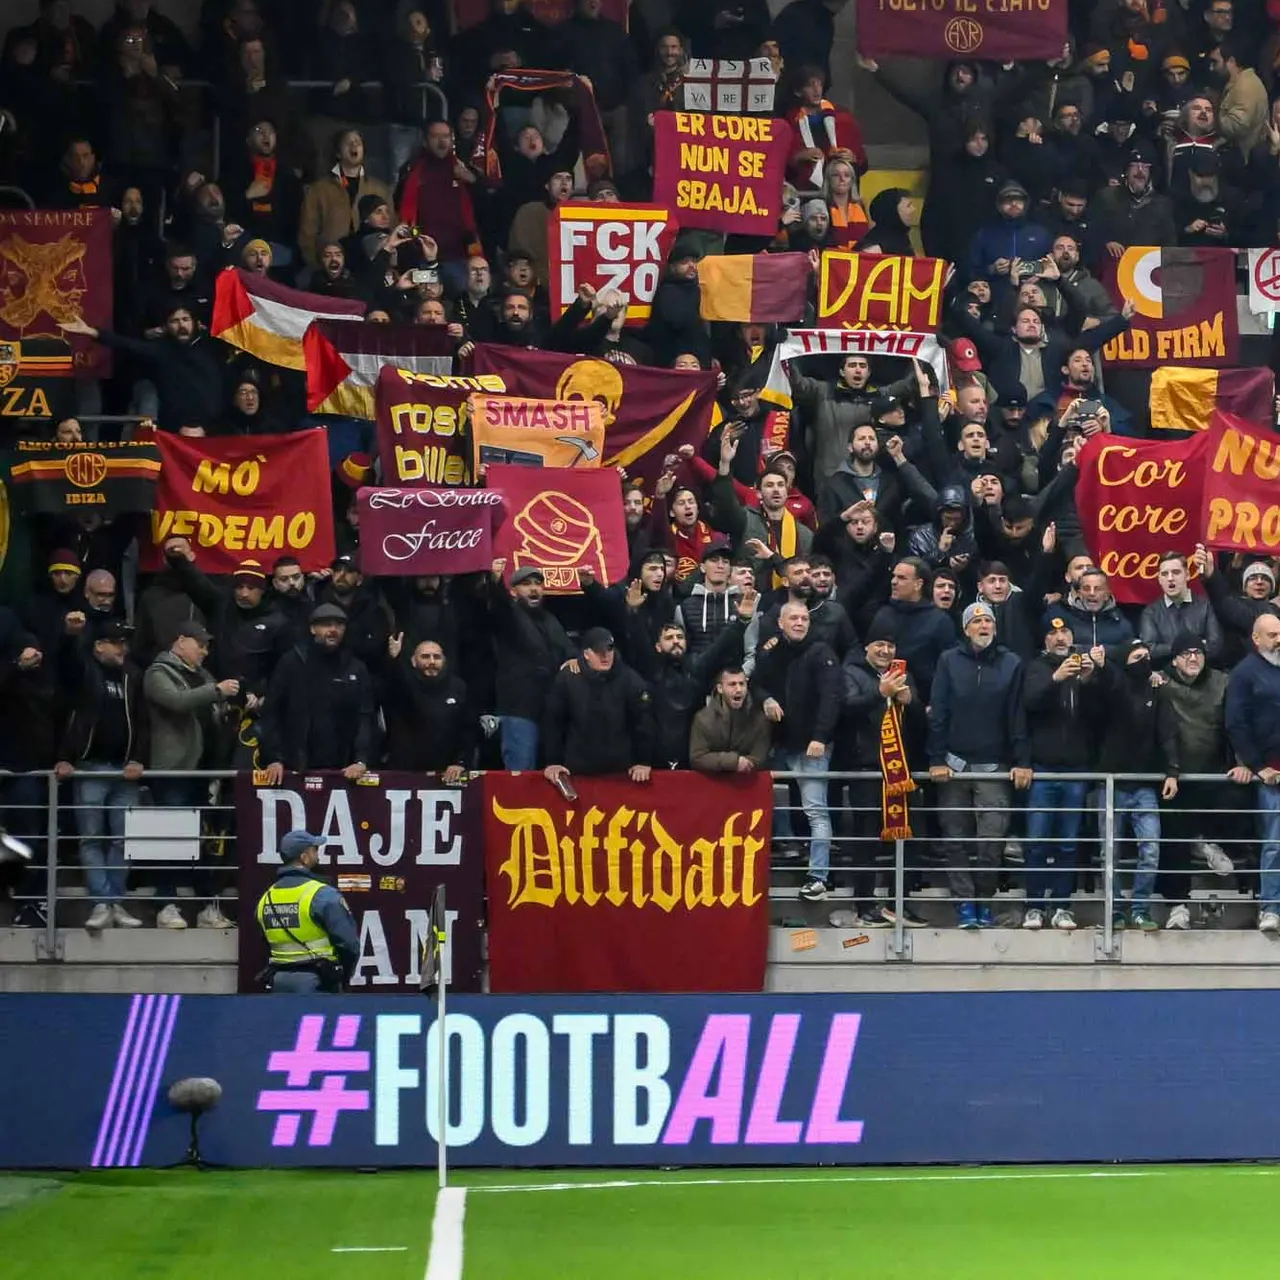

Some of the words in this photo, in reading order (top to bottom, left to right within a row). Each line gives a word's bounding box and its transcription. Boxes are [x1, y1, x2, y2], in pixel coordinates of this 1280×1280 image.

[675, 111, 706, 136] ER
[713, 115, 773, 142] CORE
[680, 143, 729, 176] NUN
[738, 150, 766, 178] SE
[25, 212, 93, 227] SEMPRE
[559, 220, 667, 263] FCK
[792, 330, 830, 354] TI
[841, 332, 926, 357] AMO
[1157, 311, 1225, 359] FIRM
[396, 368, 507, 393] roma
[485, 400, 591, 432] SMASH
[1097, 445, 1187, 488] Cor
[65, 493, 107, 505] IBIZA
[152, 510, 317, 551] VEDEMO
[1098, 503, 1189, 535] core
[256, 788, 463, 867] DAJE
[491, 794, 767, 914] Diffidati
[257, 1012, 865, 1147] #FOOTBALL
